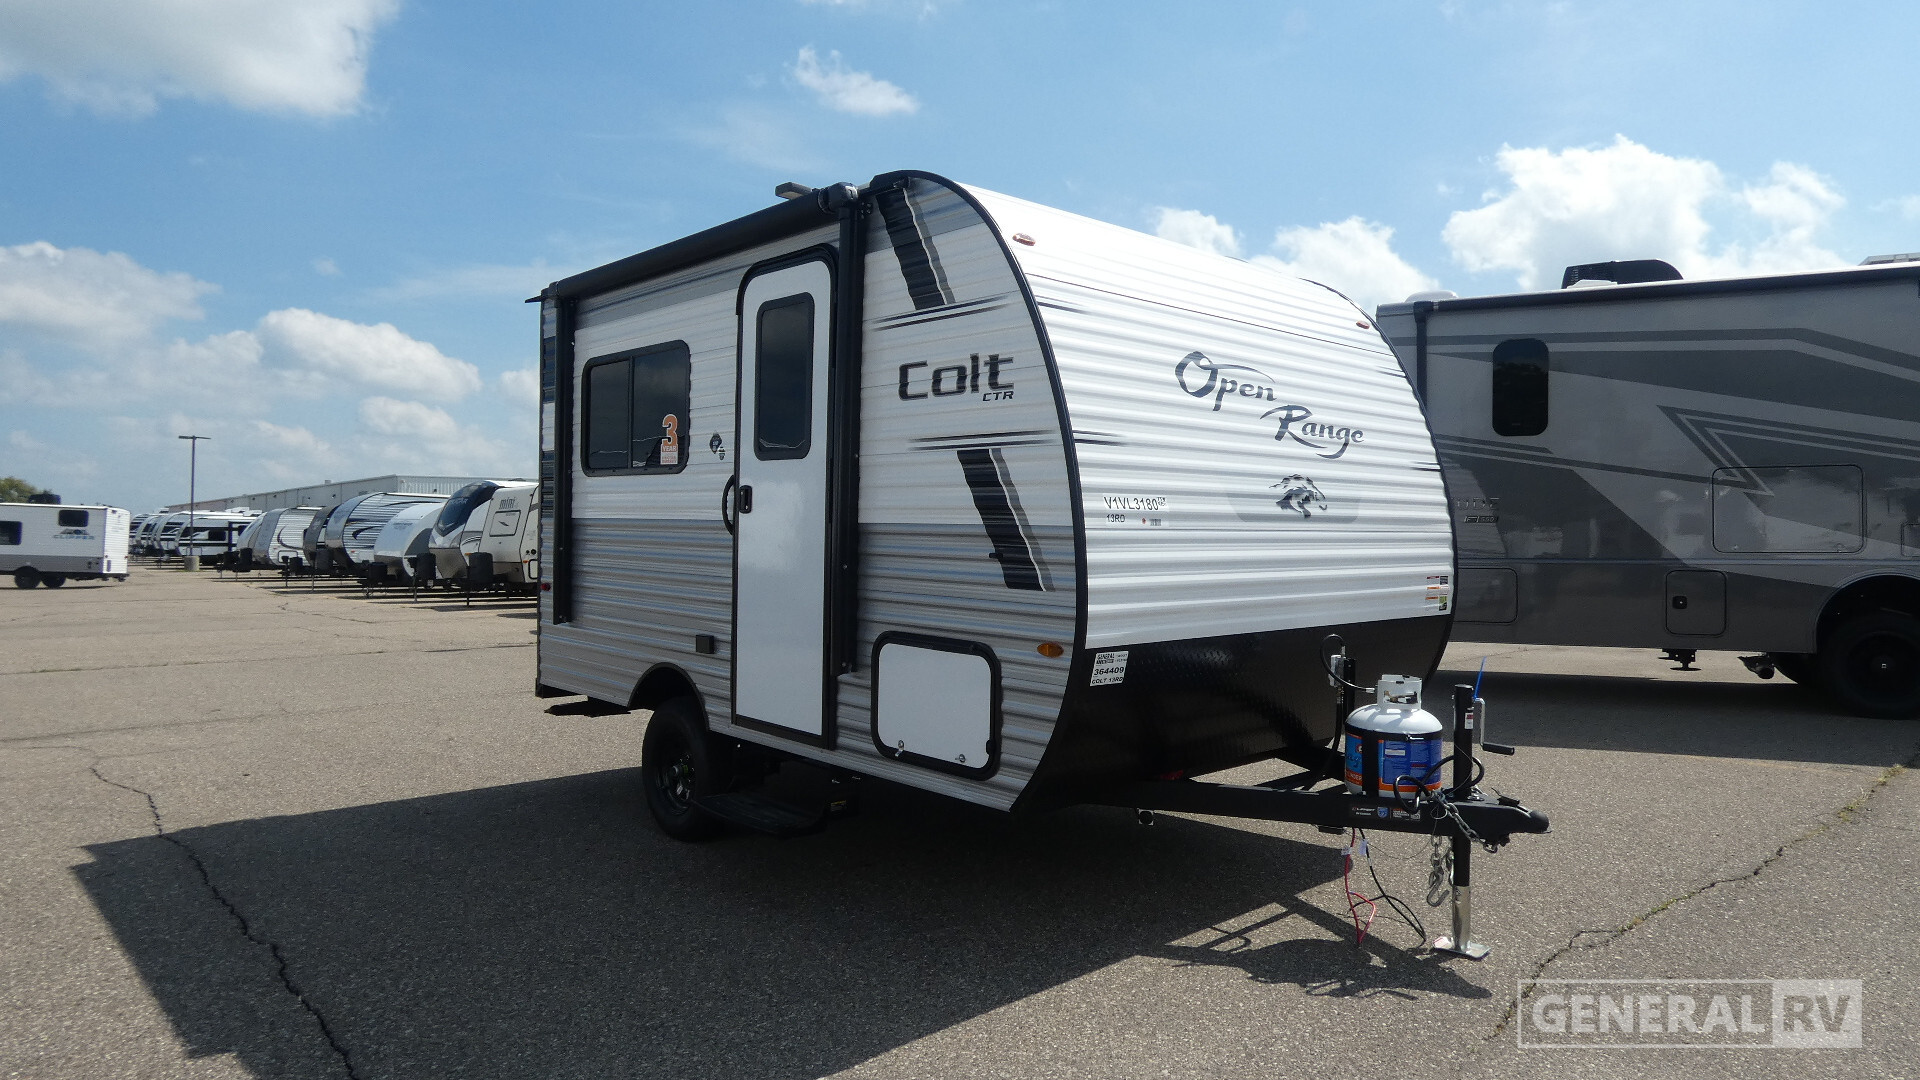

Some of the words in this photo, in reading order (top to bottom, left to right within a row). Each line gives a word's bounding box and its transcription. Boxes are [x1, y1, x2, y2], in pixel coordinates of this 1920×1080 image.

[899, 353, 1014, 401] Colt
[1175, 351, 1277, 411] Open
[982, 390, 1014, 401] CTR
[662, 413, 678, 446] 3
[1260, 404, 1365, 459] Range
[1103, 496, 1158, 510] V1VL3180
[1094, 667, 1125, 676] 364409
